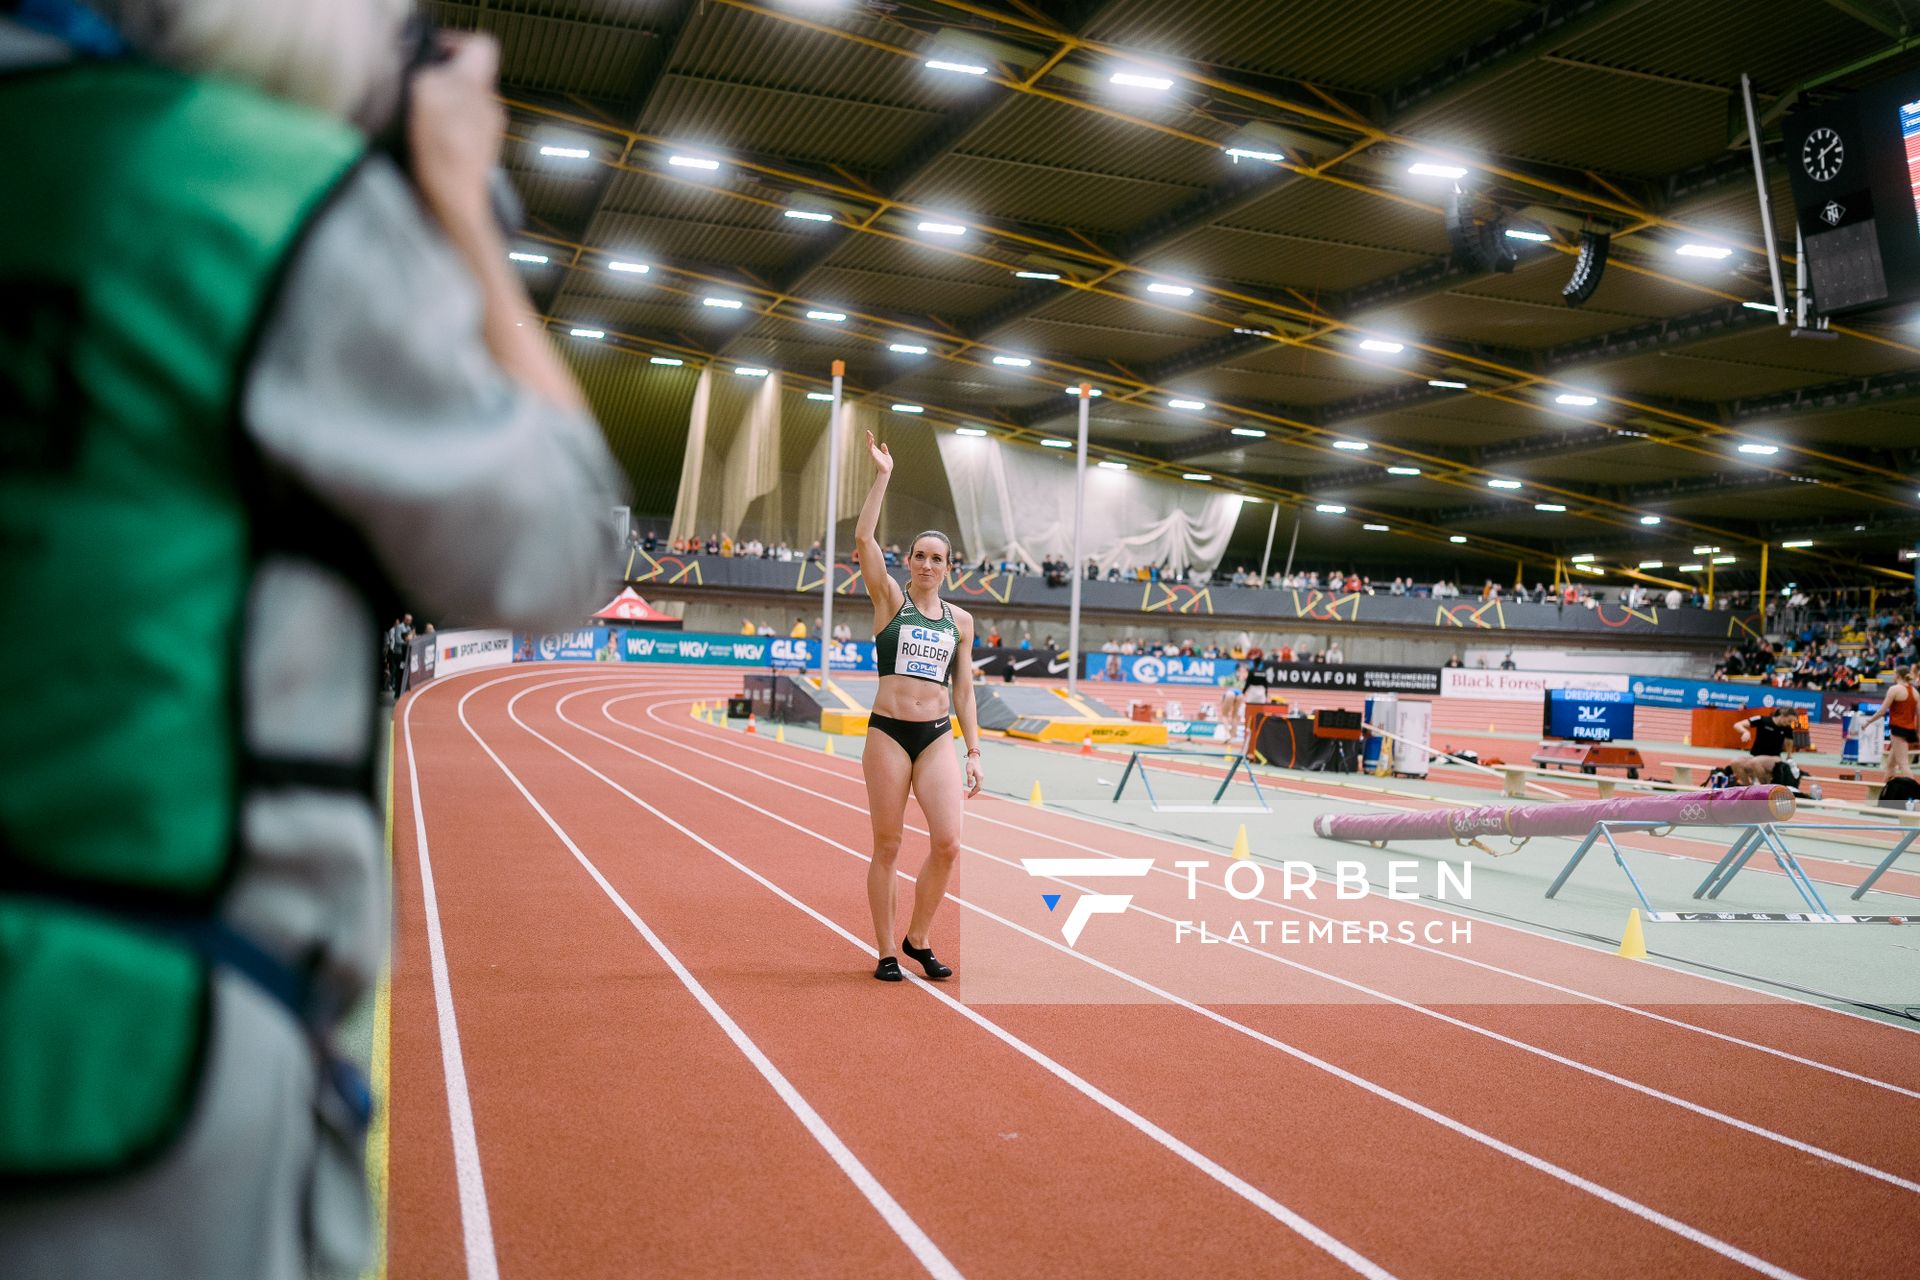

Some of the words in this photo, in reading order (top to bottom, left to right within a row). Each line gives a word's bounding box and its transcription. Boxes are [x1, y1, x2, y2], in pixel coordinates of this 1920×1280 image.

[562, 631, 594, 650] PLAN
[627, 638, 656, 656] WGV
[679, 640, 709, 658] WGV
[733, 643, 765, 660] WGV
[901, 641, 949, 662] ROLEDER
[1167, 659, 1215, 677] PLAN
[1277, 669, 1358, 685] NOVAFON
[1452, 673, 1495, 688] Black
[1500, 676, 1547, 690] Forest
[1564, 689, 1621, 702] DREISPRUNG
[1573, 727, 1610, 739] FRAUEN
